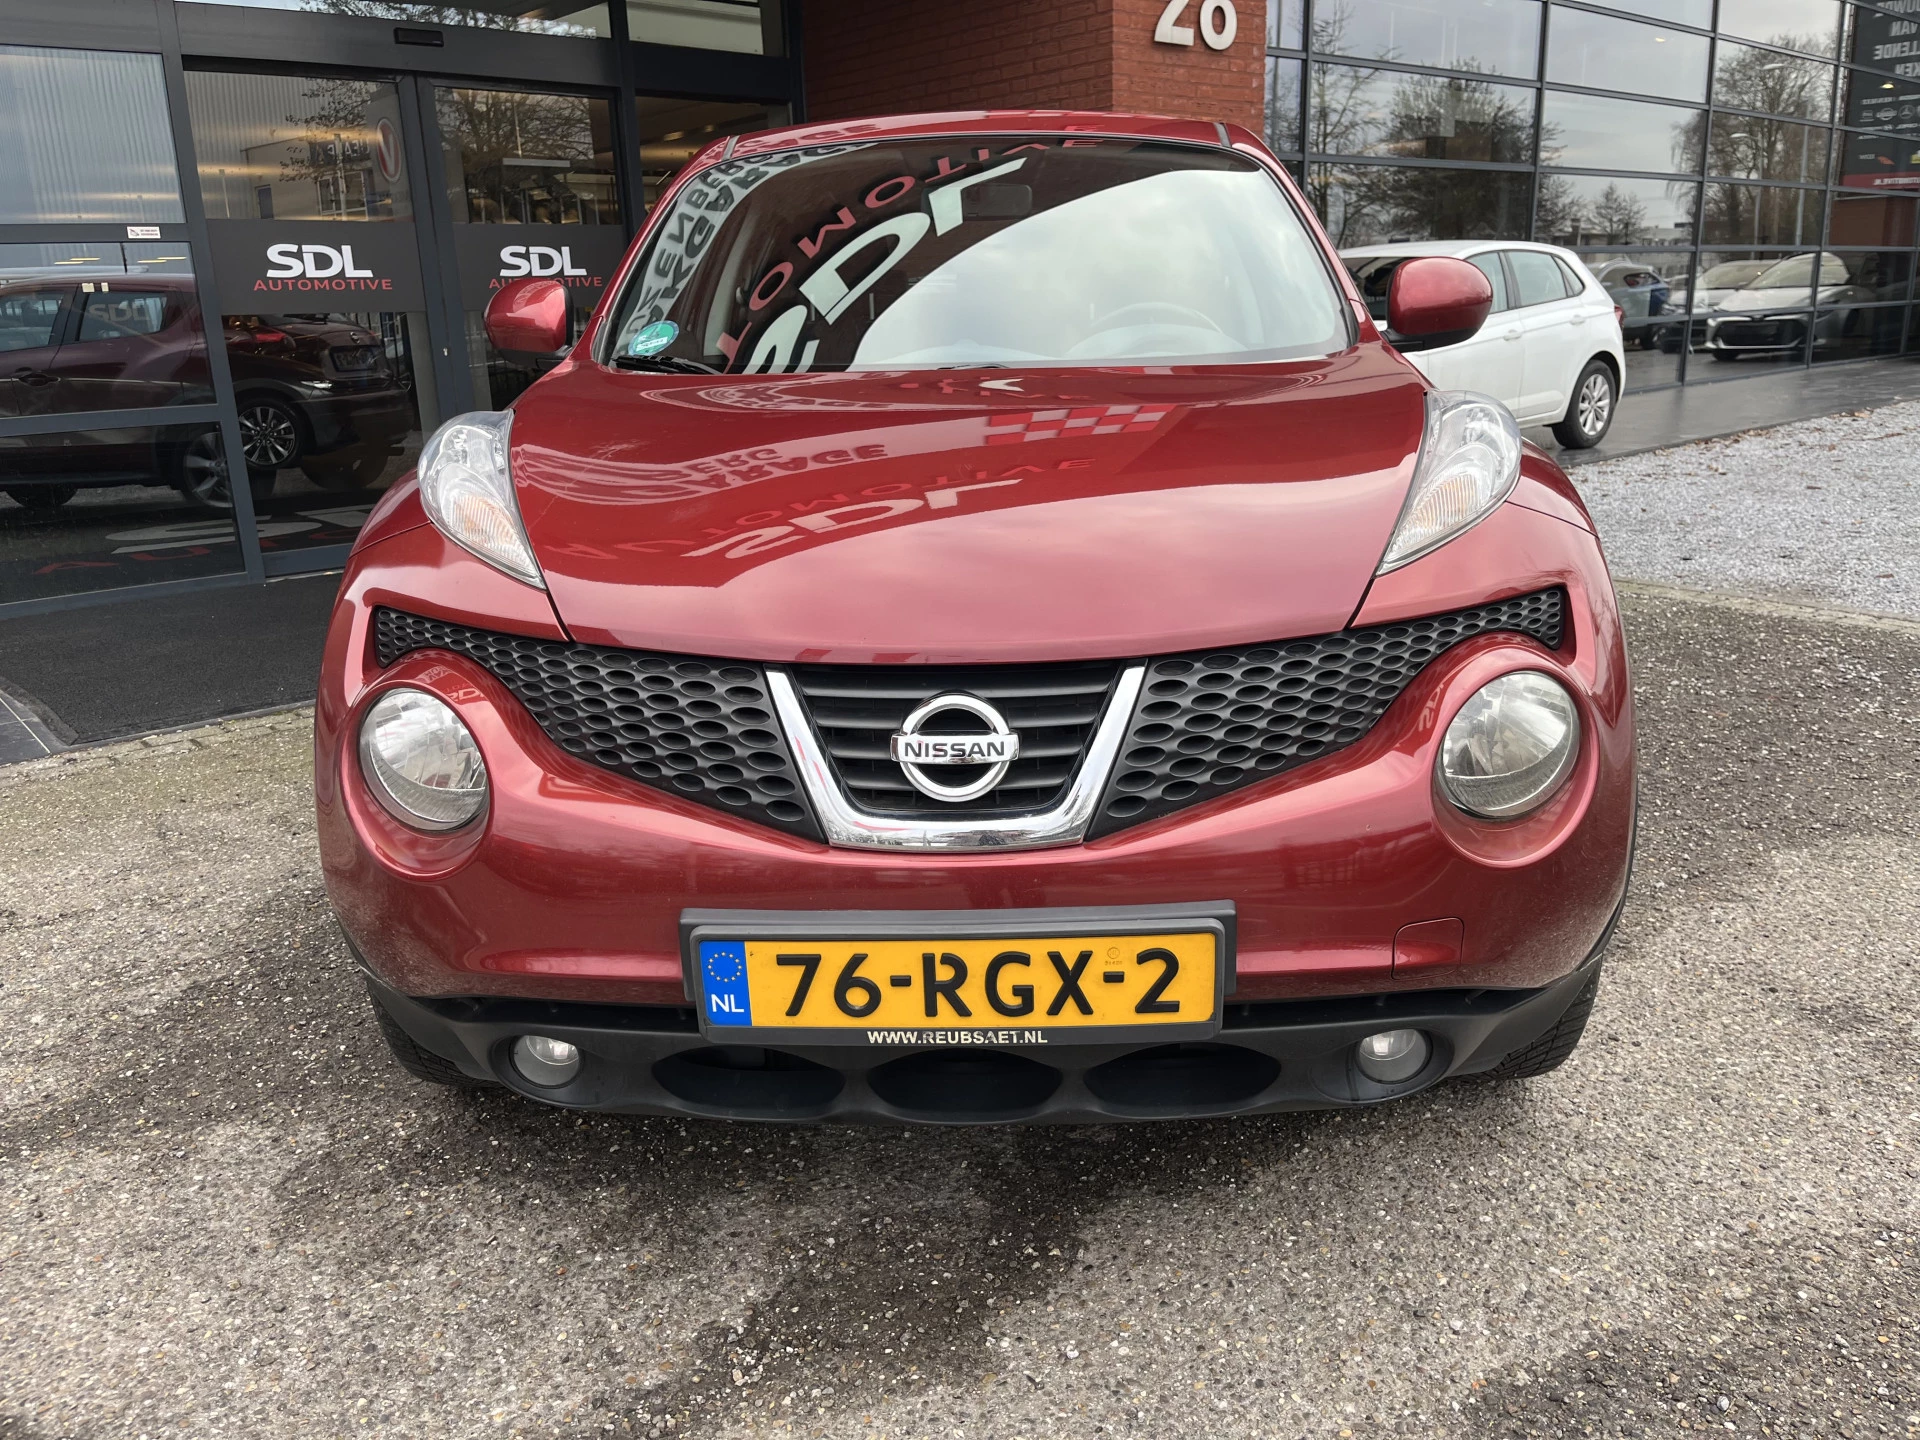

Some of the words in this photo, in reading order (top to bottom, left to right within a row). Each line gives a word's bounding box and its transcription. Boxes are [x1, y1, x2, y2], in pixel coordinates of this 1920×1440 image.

[1154, 0, 1238, 51] 20
[266, 243, 374, 279] SDL
[499, 245, 588, 277] SDL
[253, 278, 393, 292] AUTOMOTIVE
[904, 741, 1005, 758] NISSAN
[775, 947, 1181, 1018] 76-RGX-2
[711, 993, 745, 1013] NL
[866, 1030, 1048, 1045] WWW.REUBSAET.NL
